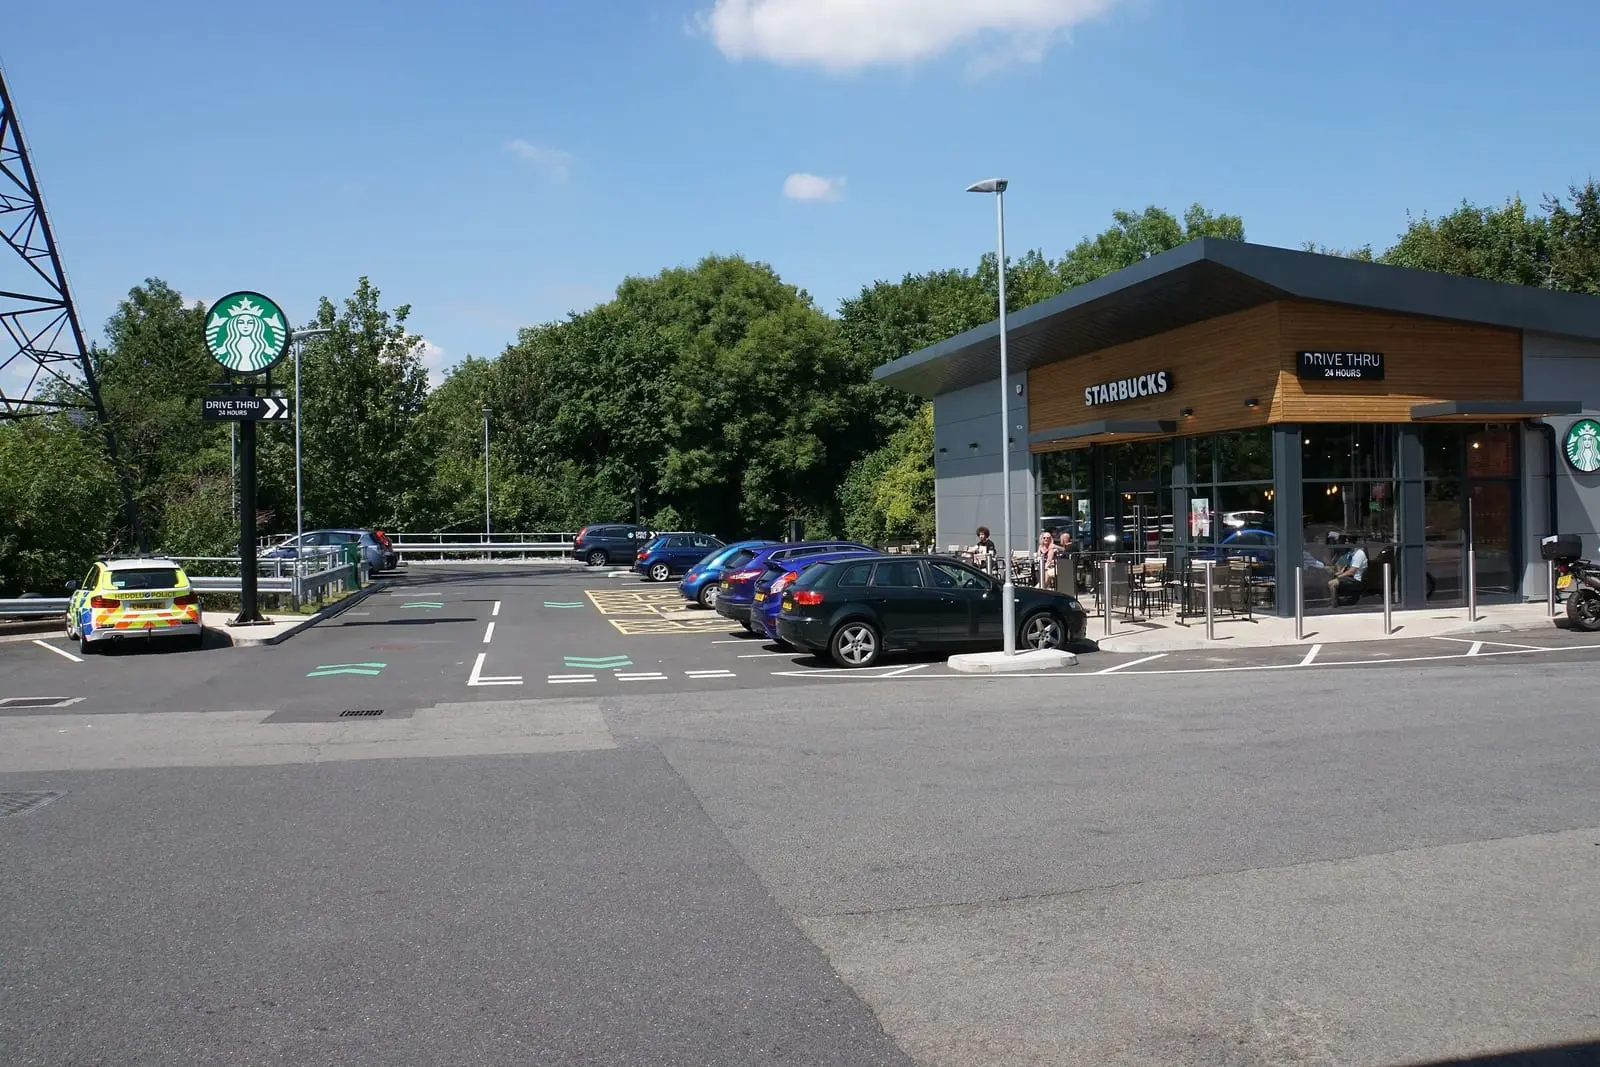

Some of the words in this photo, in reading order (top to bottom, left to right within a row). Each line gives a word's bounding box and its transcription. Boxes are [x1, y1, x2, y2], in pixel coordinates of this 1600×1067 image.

[1304, 351, 1343, 366] DRIVE
[1346, 353, 1380, 367] THRU
[1324, 368, 1334, 377] 24
[1335, 368, 1362, 378] HOURS
[1084, 371, 1167, 406] STARBUCKS
[205, 400, 233, 409] DRIVE
[235, 400, 260, 409] THRU
[114, 592, 144, 600] HEDDLU
